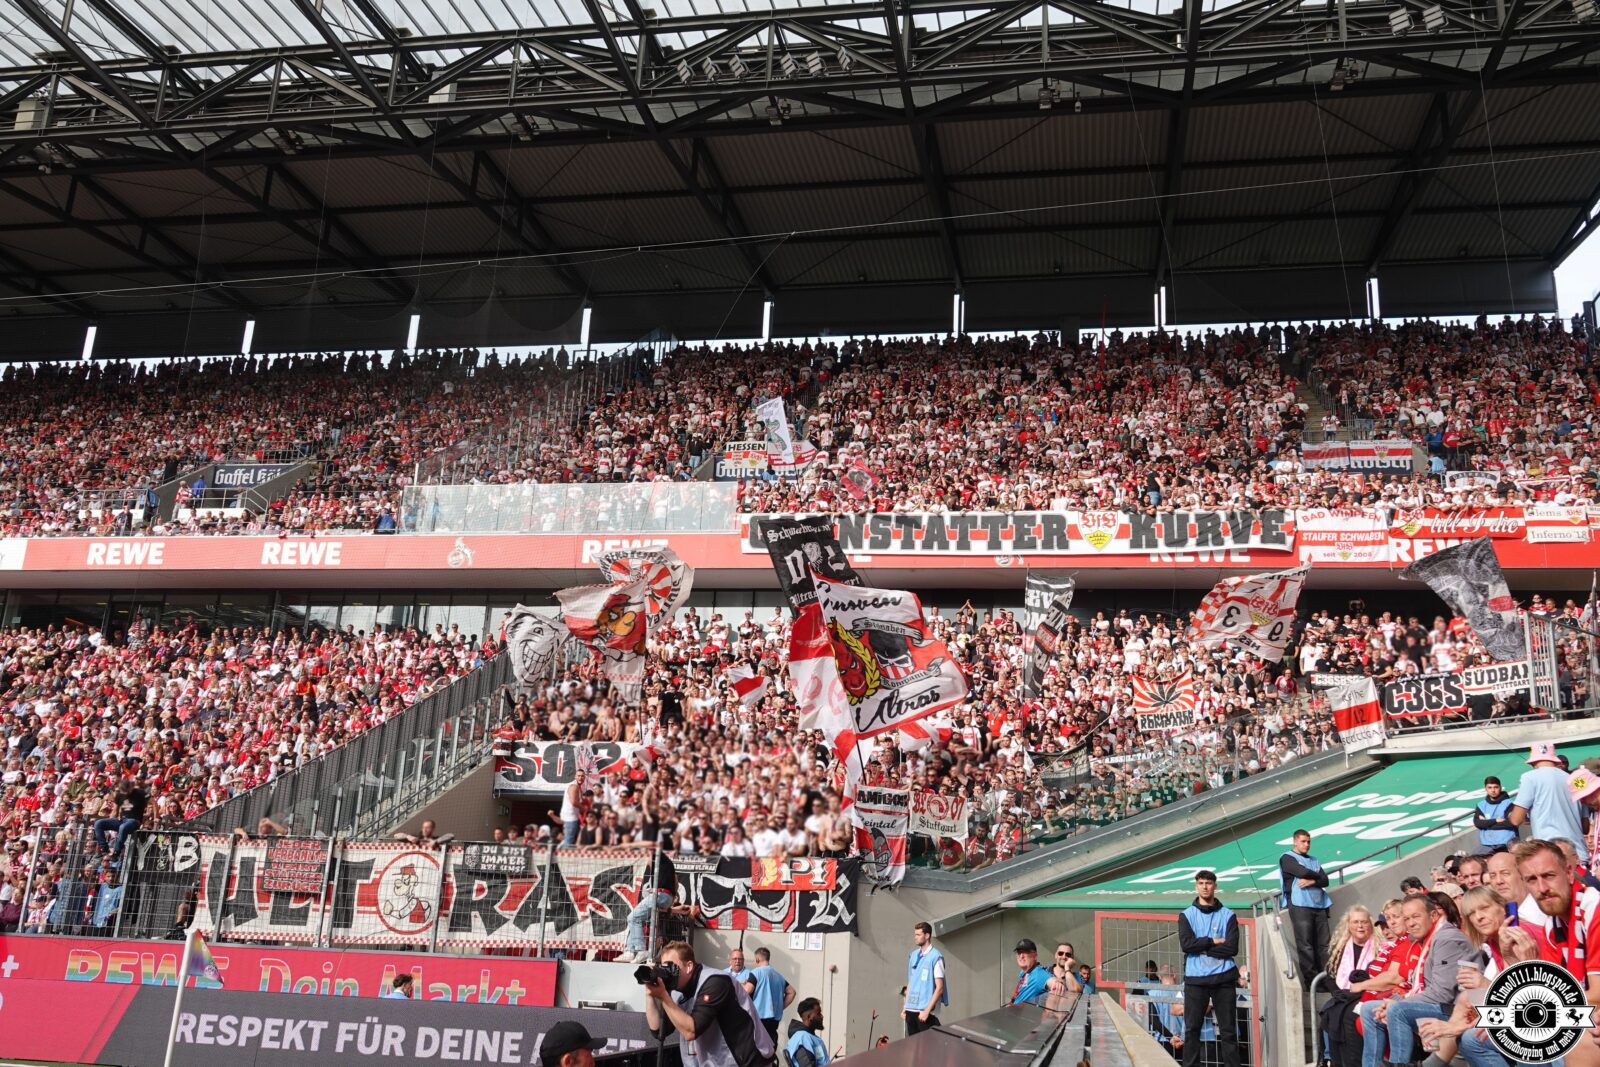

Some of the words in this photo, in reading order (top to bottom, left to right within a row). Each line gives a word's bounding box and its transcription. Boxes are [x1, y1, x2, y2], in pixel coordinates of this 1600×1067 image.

[728, 442, 766, 452] HESSEN
[214, 468, 255, 486] Gaffel
[1302, 510, 1326, 523] BAD
[1328, 508, 1382, 522] WIMPFEN
[1430, 510, 1462, 534] till
[1489, 510, 1519, 534] die
[1130, 511, 1287, 549] KURVE
[1302, 531, 1338, 541] STAUFER
[1340, 531, 1385, 541] SCHWABEN
[1531, 530, 1572, 541] Inferno
[86, 542, 166, 566] REWE
[260, 541, 343, 566] REWE
[1492, 679, 1530, 691] STUTTGART
[1386, 675, 1466, 715] C36S
[1140, 710, 1195, 721] SCHWABEN
[1140, 718, 1195, 730] KOMPANIE
[919, 816, 958, 835] Stuttgart
[1275, 807, 1476, 846] FC
[276, 840, 321, 850] JEDER
[482, 845, 498, 854] DU
[502, 846, 527, 856] BIST
[268, 847, 328, 862] VERBANNTE
[481, 855, 526, 865] IMMER
[258, 958, 359, 996] Dein
[379, 965, 527, 1006] Markt
[175, 1012, 328, 1052] RESPEKT
[336, 1015, 408, 1056] FÜR
[415, 1024, 523, 1063] DEINE
